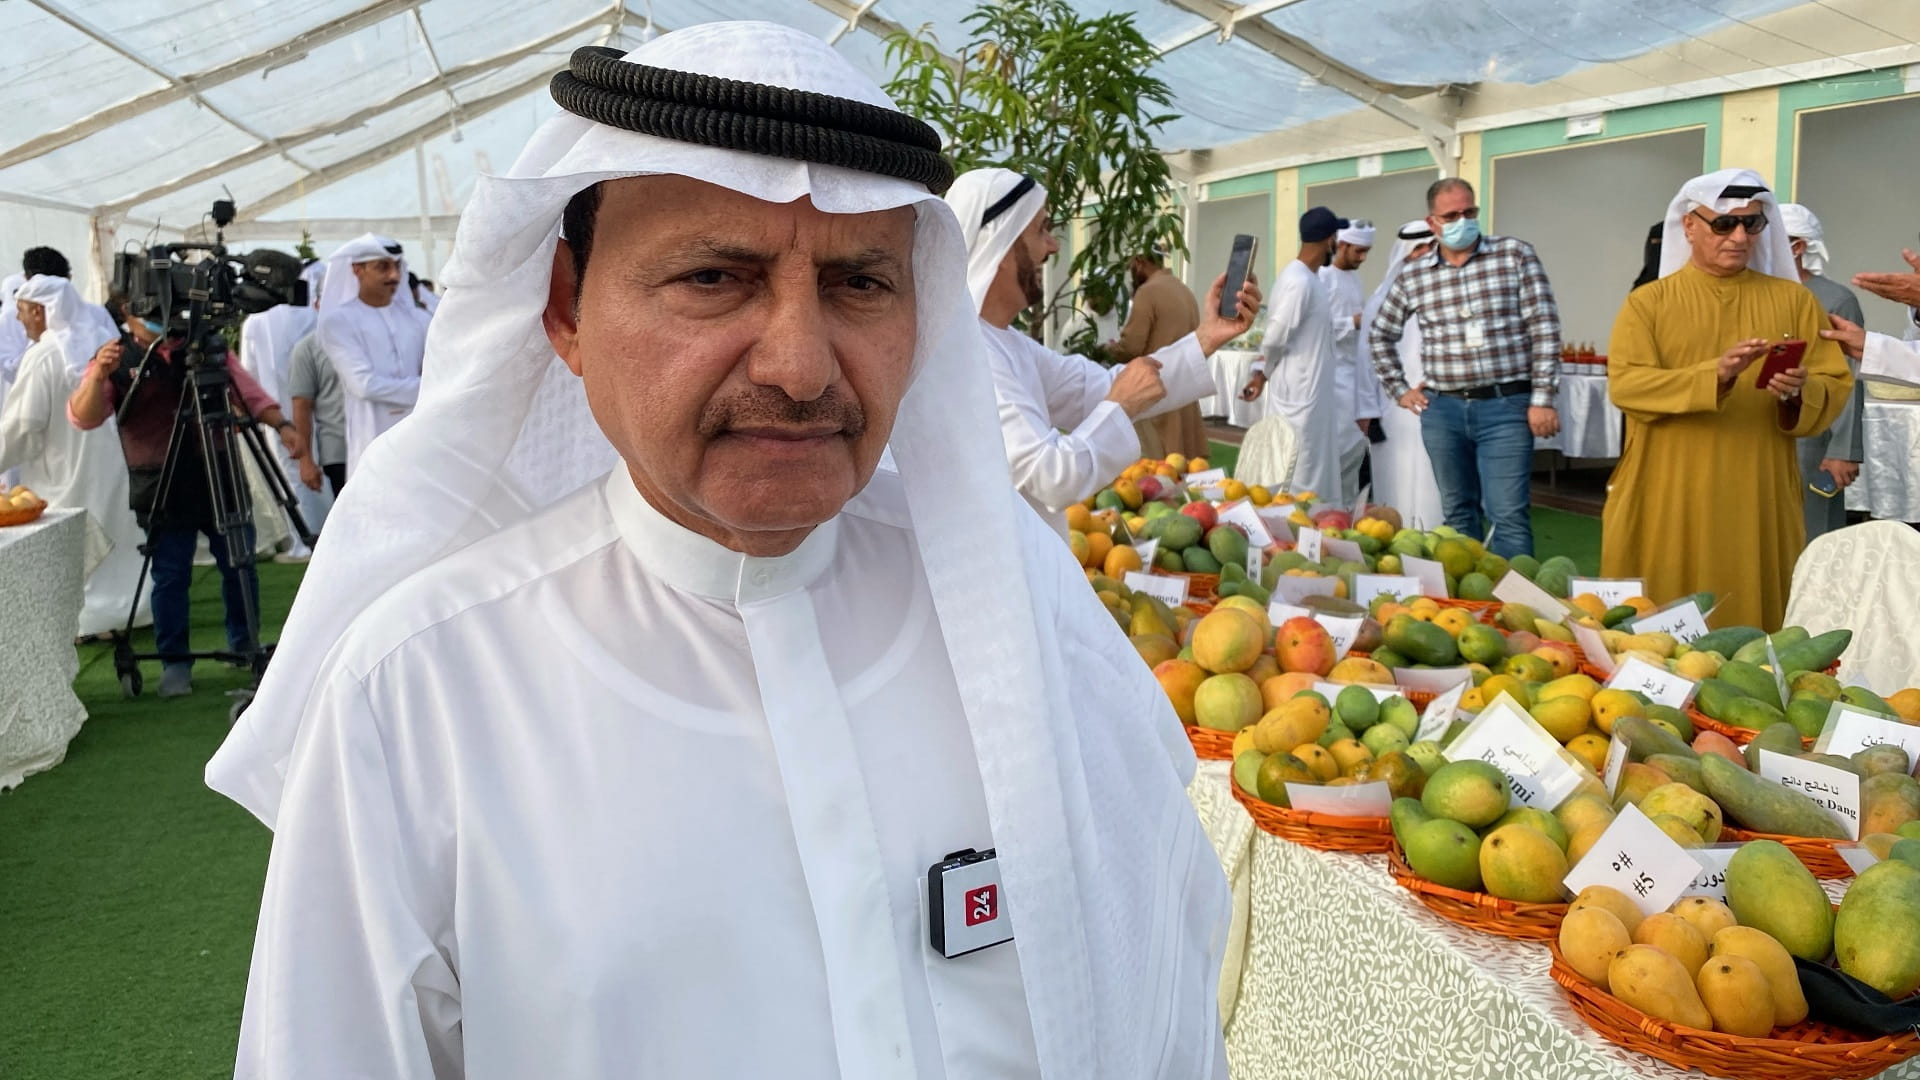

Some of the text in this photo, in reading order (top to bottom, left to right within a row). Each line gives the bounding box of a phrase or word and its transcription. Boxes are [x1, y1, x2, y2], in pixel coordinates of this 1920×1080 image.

[1827, 799, 1857, 820] Dang
[1632, 871, 1655, 898] #5
[973, 890, 990, 920] 24
